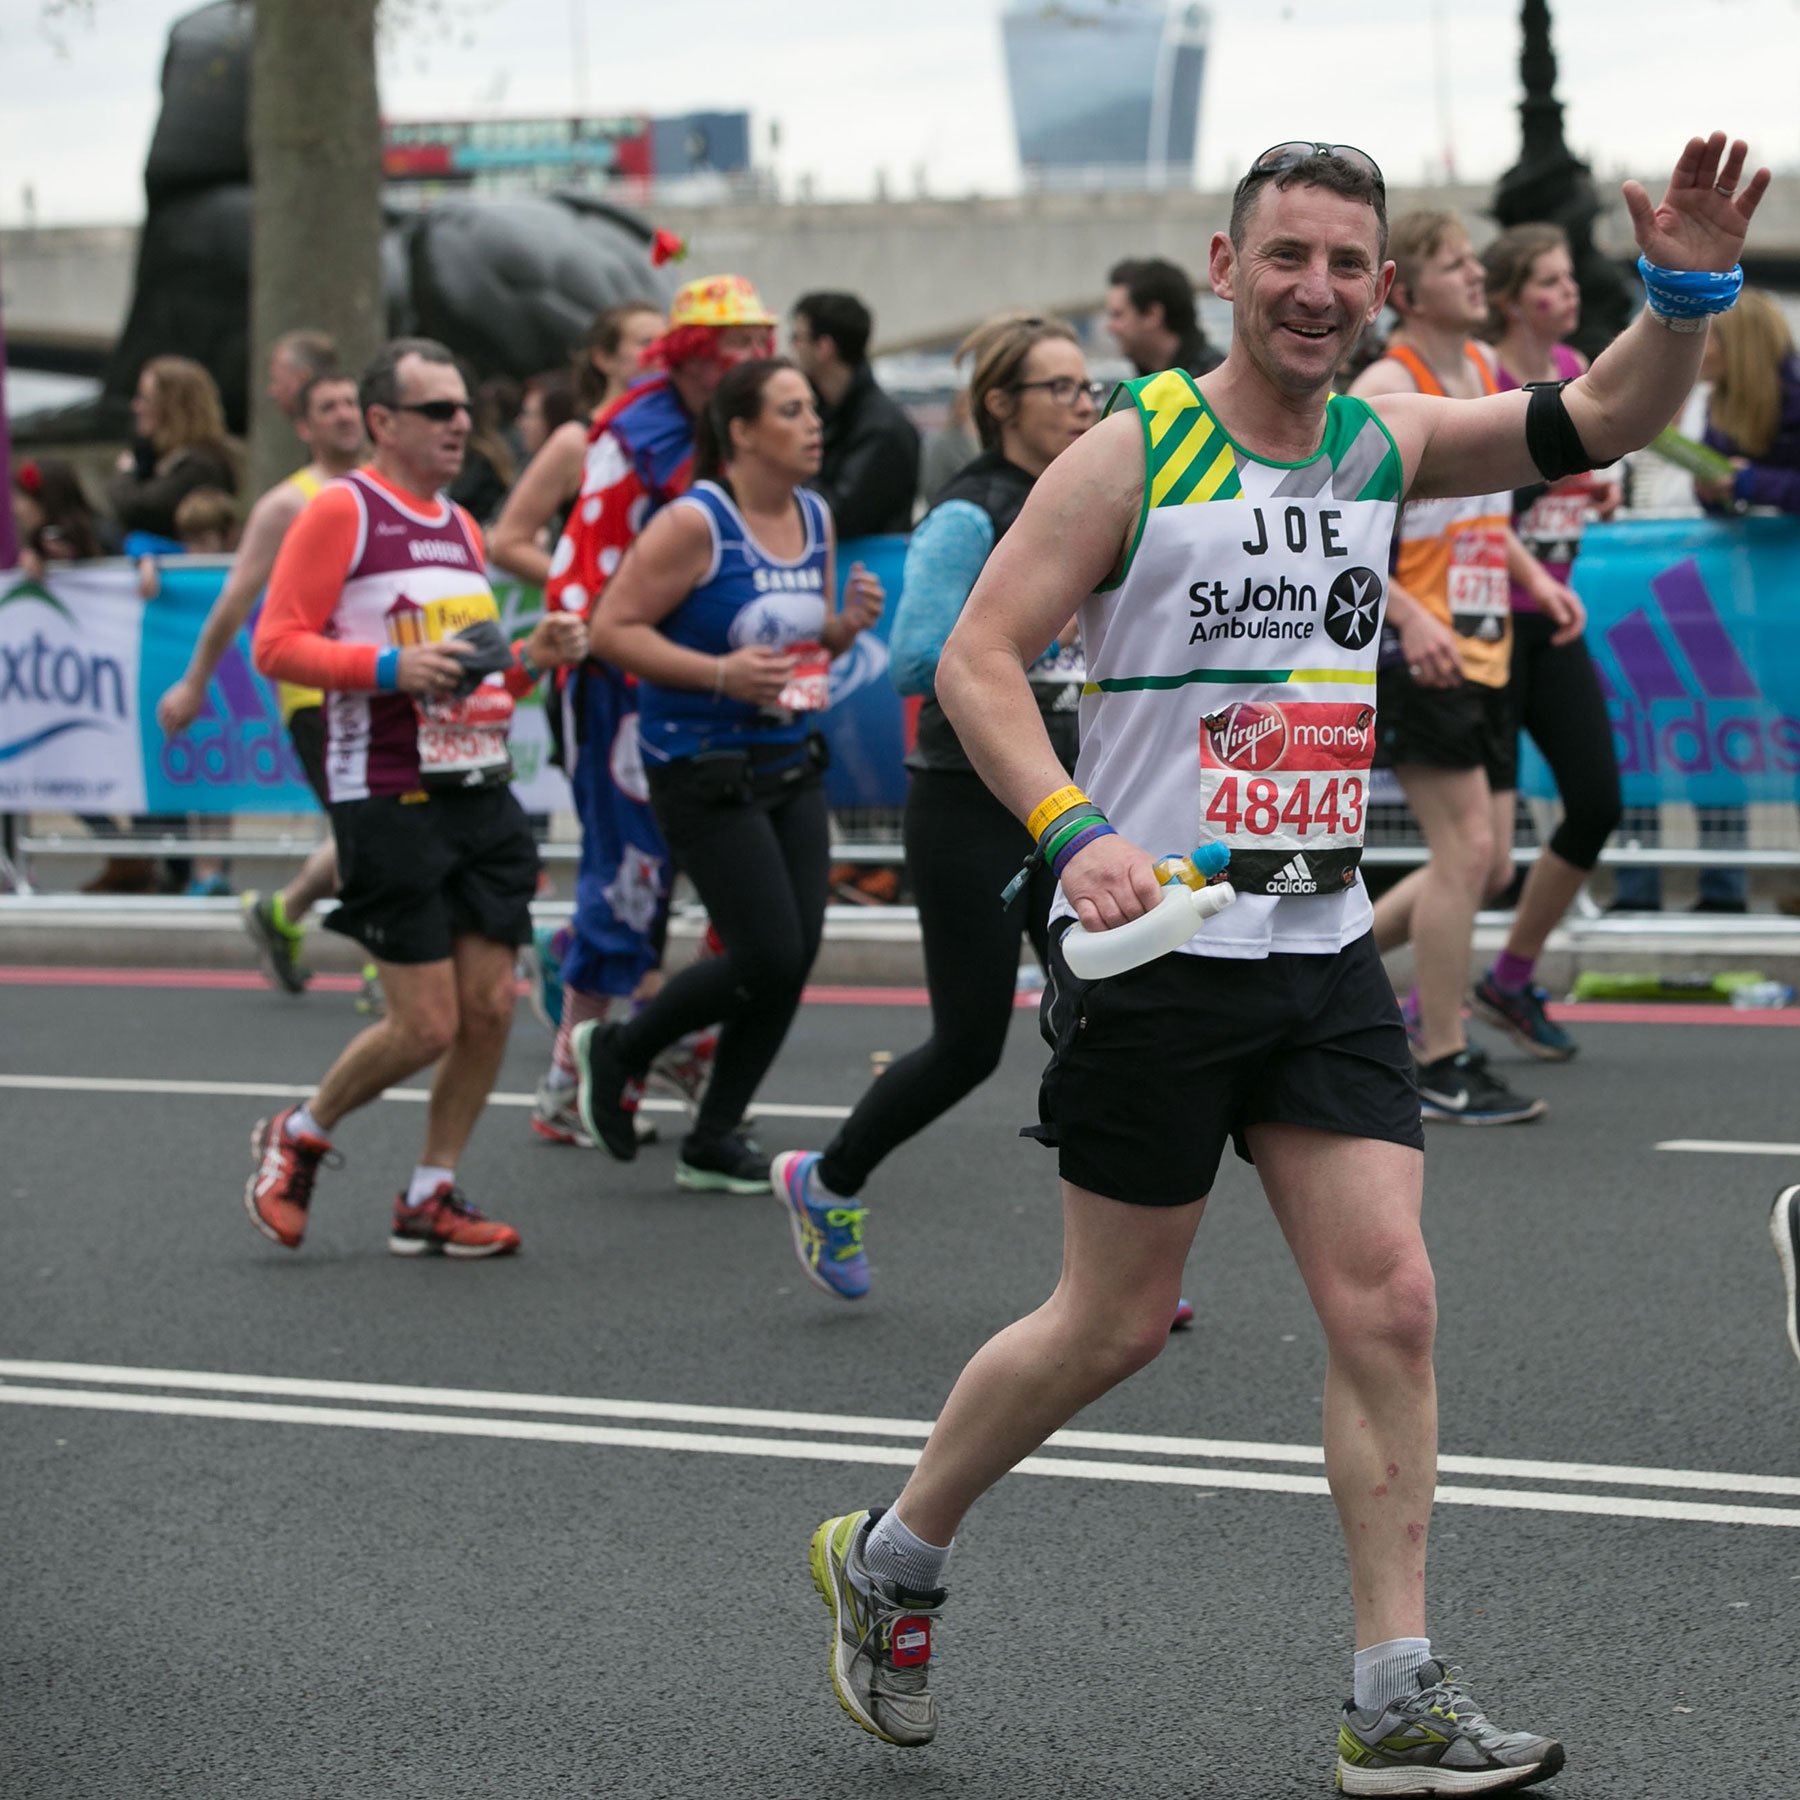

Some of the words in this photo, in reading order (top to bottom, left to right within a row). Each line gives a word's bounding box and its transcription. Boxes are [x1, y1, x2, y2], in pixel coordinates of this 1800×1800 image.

[1242, 505, 1348, 558] JOE
[1188, 581, 1229, 617] St
[1234, 575, 1317, 612] John
[1188, 616, 1315, 645] Ambulance
[0, 630, 126, 719] xton
[161, 720, 306, 785] adid
[1213, 703, 1282, 766] Virgin
[1293, 722, 1369, 753] money
[1609, 701, 1800, 776] didas
[1205, 776, 1364, 836] 48443
[1265, 879, 1318, 894] adidas
